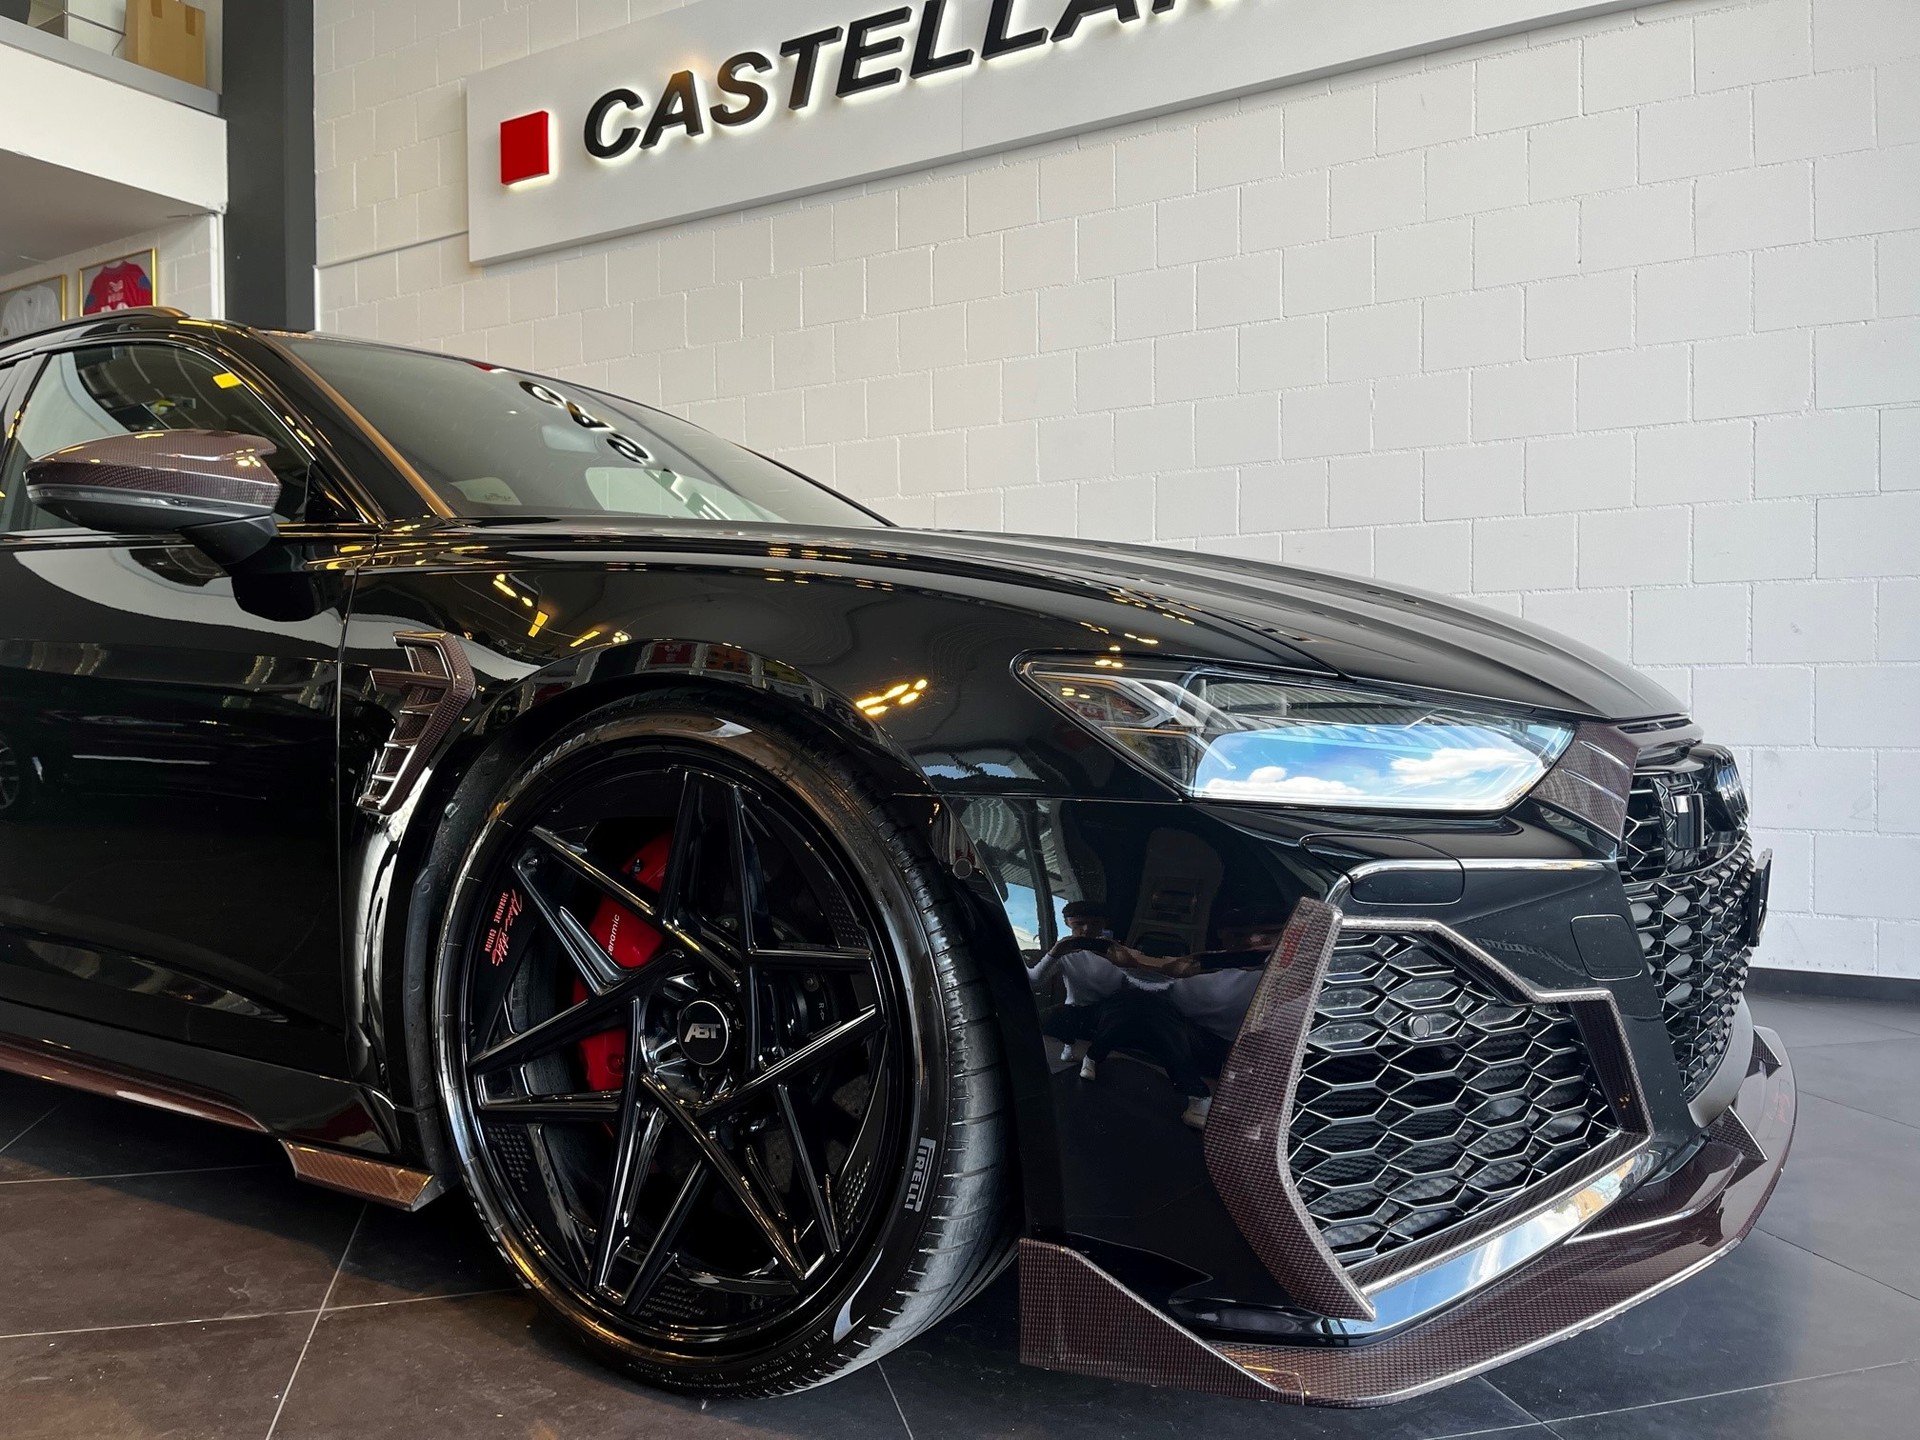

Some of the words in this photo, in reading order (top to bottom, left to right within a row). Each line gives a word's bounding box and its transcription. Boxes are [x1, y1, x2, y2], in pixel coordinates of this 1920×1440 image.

[583, 0, 1174, 160] CASTELL
[684, 1023, 721, 1043] ABT
[903, 1136, 937, 1213] PIRELLI
